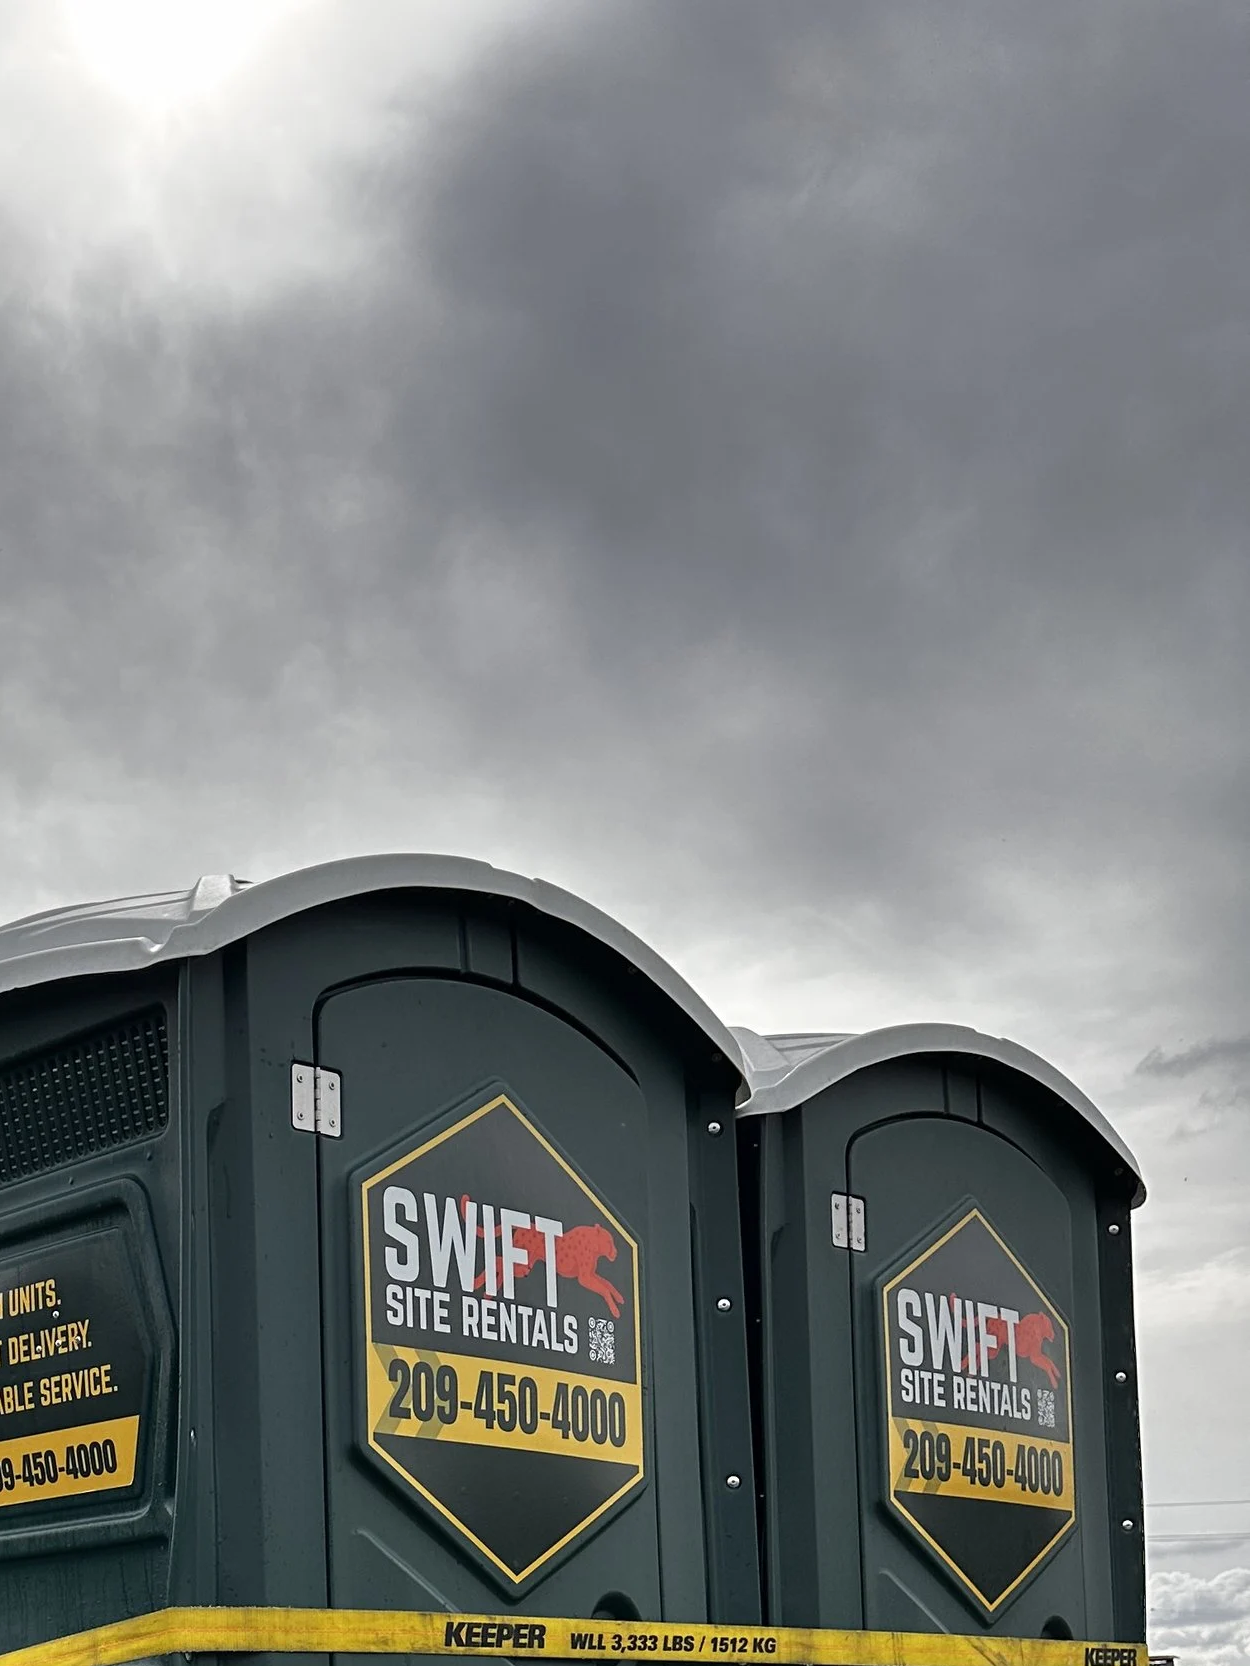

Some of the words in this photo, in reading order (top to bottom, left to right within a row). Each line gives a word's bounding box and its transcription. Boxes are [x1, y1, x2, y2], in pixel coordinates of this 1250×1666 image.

[383, 1185, 564, 1307] SWIFT
[8, 1278, 62, 1318] UNITS.
[385, 1284, 451, 1334] SITE
[462, 1295, 579, 1355] RENTALS
[8, 1318, 93, 1367] DELIVERY.
[897, 1287, 1020, 1384] SWIFT
[40, 1363, 120, 1407] SERVICE.
[387, 1358, 627, 1448] 209-450-4000
[900, 1368, 948, 1409] SITE
[952, 1377, 1032, 1421] RENTALS
[902, 1430, 1064, 1498] 209-450-4000
[444, 1620, 547, 1650] KEEPER
[569, 1631, 608, 1652] WLL
[610, 1632, 659, 1654] 3,333
[661, 1633, 696, 1653] LBS
[710, 1635, 748, 1655] 1512
[750, 1636, 778, 1655] KG
